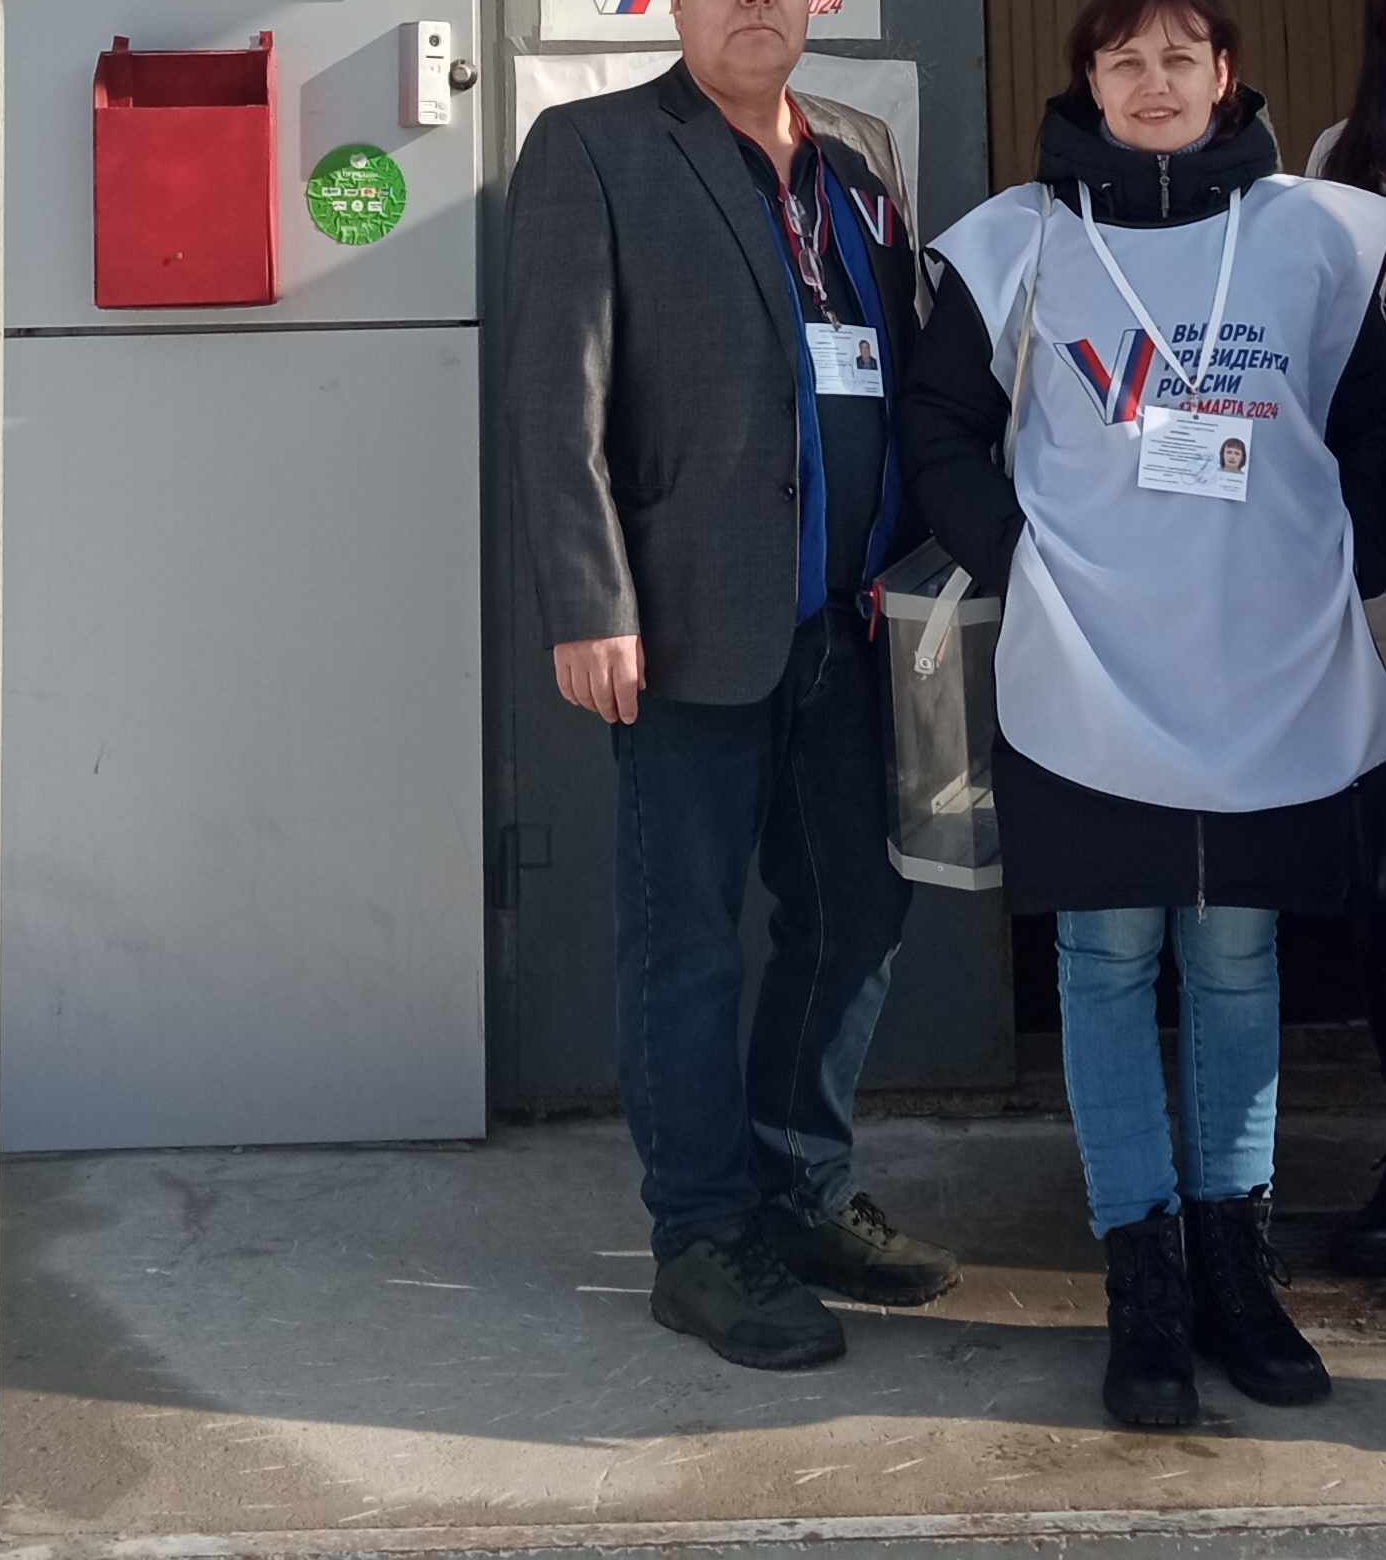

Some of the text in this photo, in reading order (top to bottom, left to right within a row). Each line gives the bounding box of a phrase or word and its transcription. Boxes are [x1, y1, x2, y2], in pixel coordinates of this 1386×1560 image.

[1172, 322, 1265, 344] ВЫОРЫ
[1197, 398, 1244, 417] МАРТА
[1247, 401, 1279, 419] 2024
